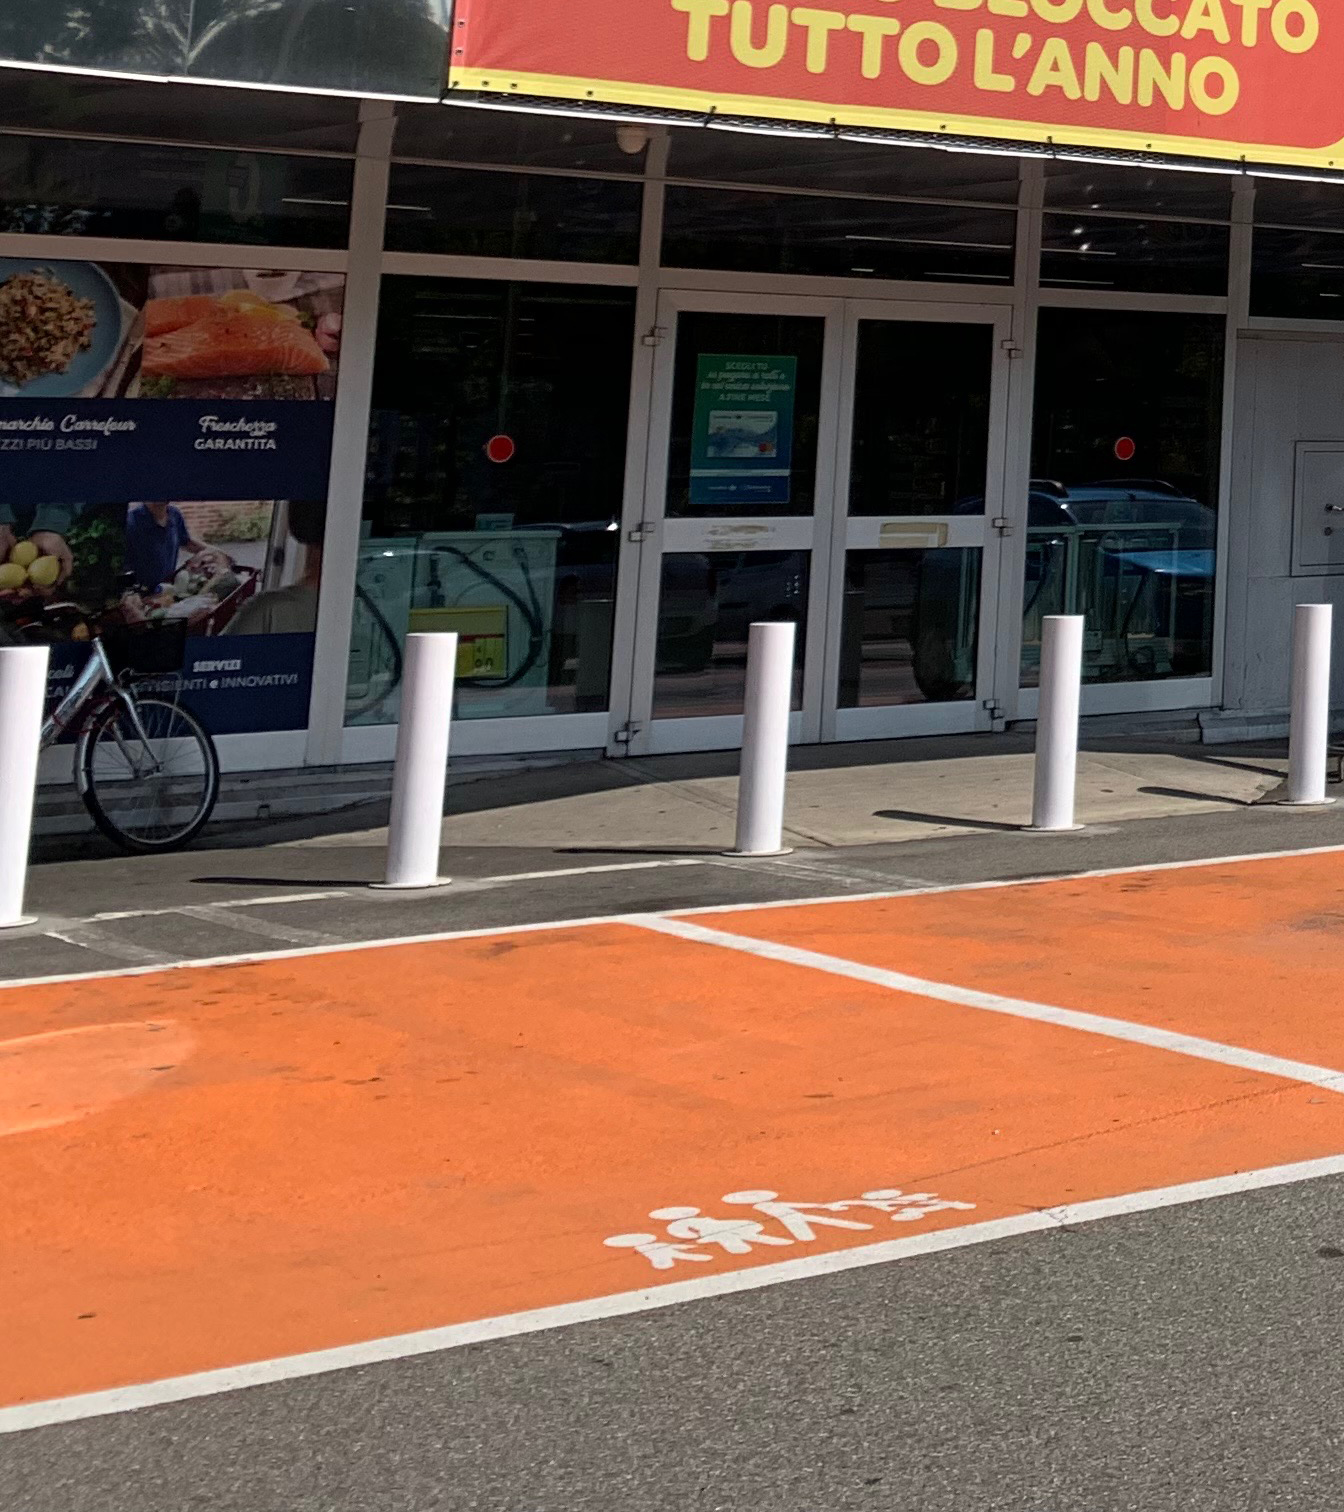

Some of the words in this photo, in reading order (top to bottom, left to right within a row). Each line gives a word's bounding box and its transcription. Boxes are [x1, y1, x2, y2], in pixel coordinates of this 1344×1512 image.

[973, 28, 1241, 116] L'ANNO
[60, 414, 137, 436] Carrefour
[197, 414, 277, 437] Freschezza
[55, 438, 98, 450] BASSI
[194, 438, 277, 450] GARANTITA
[221, 673, 298, 689] INNOVATIVI
